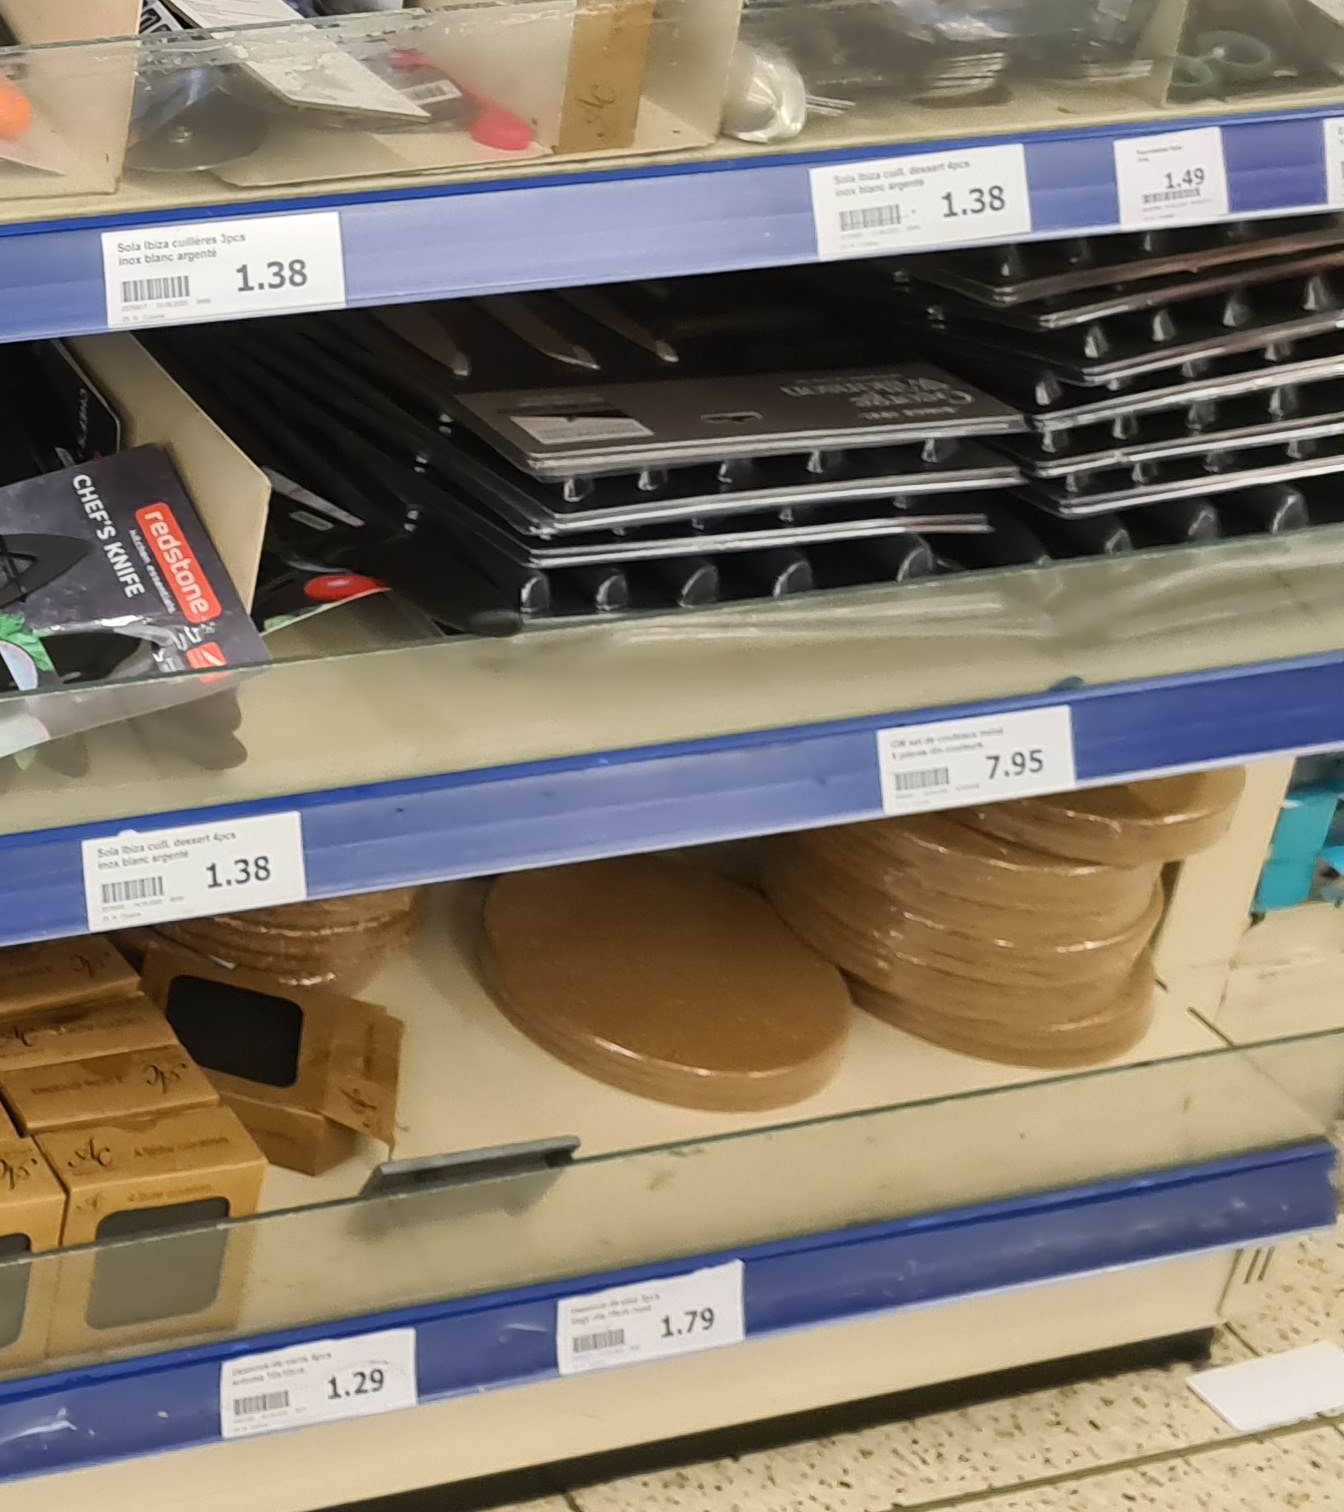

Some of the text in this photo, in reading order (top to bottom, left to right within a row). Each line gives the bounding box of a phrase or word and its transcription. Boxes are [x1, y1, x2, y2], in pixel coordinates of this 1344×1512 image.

[1164, 168, 1205, 190] 1.49
[941, 185, 1005, 218] 1.38
[117, 232, 246, 254] Sola Ibiza cuillères 3pcs
[118, 248, 217, 266] inox blanc argenté
[235, 259, 308, 292] 1.38
[72, 473, 145, 600] CHEF'S KNIFE
[144, 510, 209, 615] redstone
[985, 749, 1044, 780] 7.95
[205, 855, 271, 889] 1.38
[660, 1307, 715, 1338] 1.79
[326, 1368, 384, 1400] 1.29
